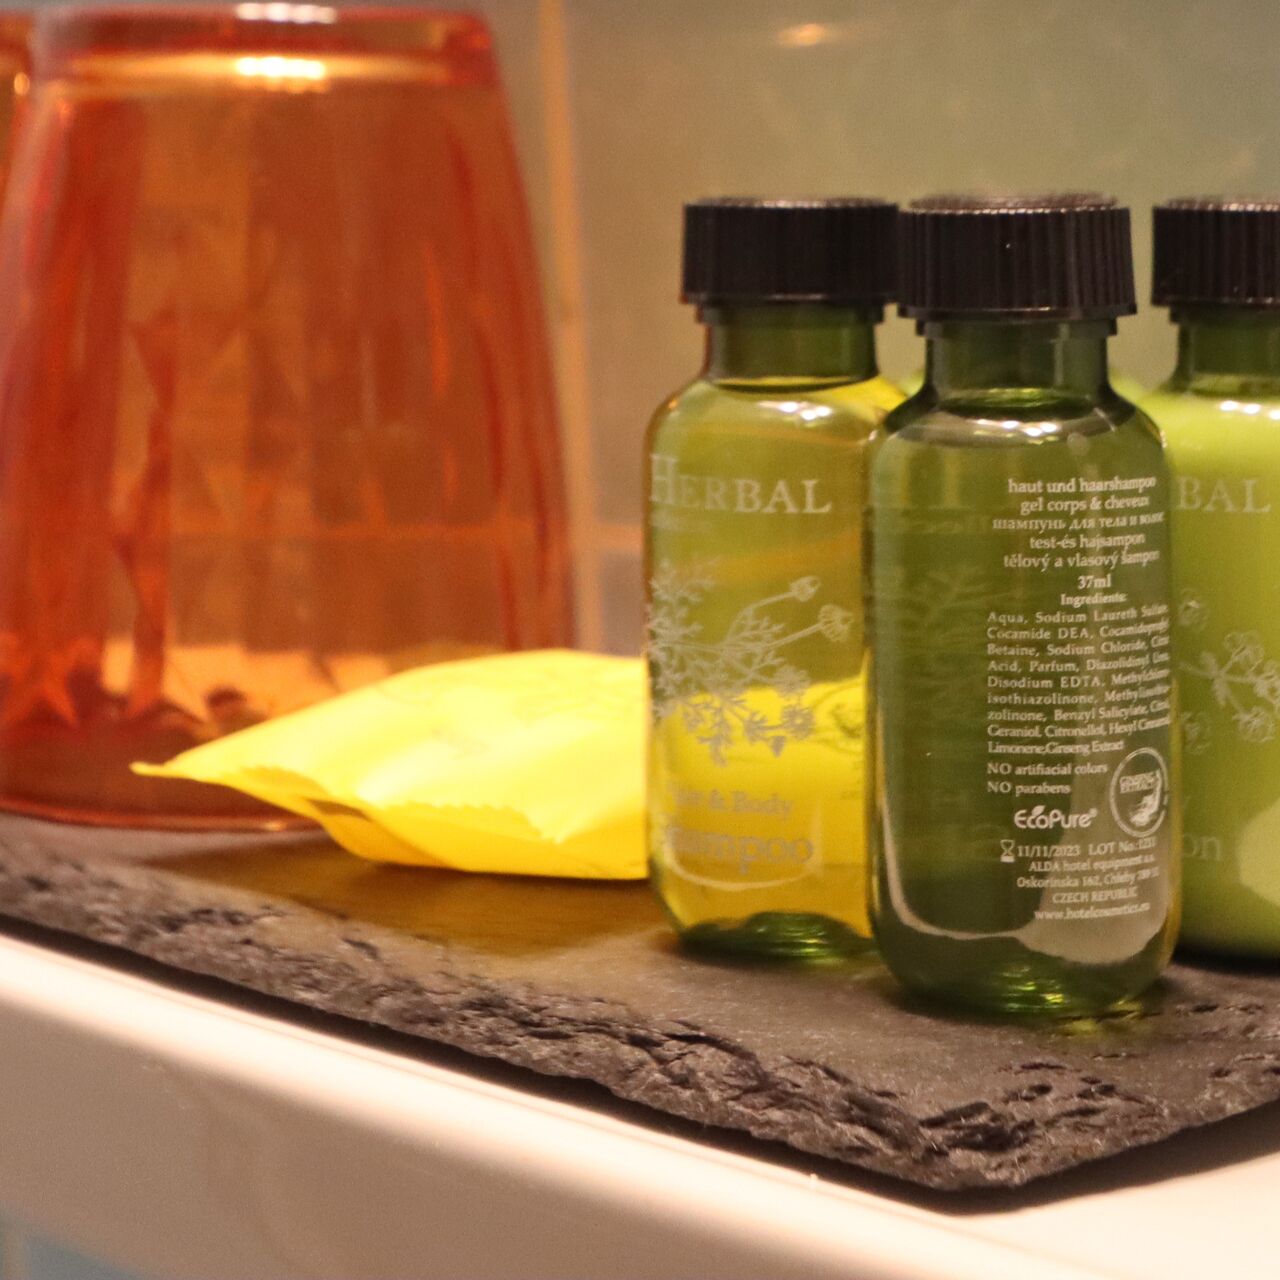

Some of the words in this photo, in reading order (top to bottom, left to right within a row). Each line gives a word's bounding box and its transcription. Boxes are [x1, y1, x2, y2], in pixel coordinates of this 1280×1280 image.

[650, 453, 832, 513] HERBAL
[1008, 479, 1044, 493] haut
[1047, 478, 1076, 493] und
[1020, 497, 1043, 515] gel
[1047, 499, 1087, 514] corps
[1089, 496, 1102, 511] &
[1054, 556, 1063, 567] a
[1067, 550, 1119, 569] vlasový
[1078, 574, 1111, 590] 37ml
[988, 612, 1028, 626] Aqua,
[1035, 612, 1087, 623] Sodium
[1094, 607, 1137, 622] Laureth
[987, 627, 1051, 639] Cocamide
[987, 644, 1040, 656] Betaine,
[1047, 644, 1095, 656] Sodium
[988, 661, 1022, 673] Acid,
[1029, 661, 1079, 672] Parfum,
[987, 676, 1053, 688] Disodium
[988, 693, 1098, 705] isothiazolinone,
[988, 710, 1047, 721] zolinone,
[1054, 709, 1095, 724] Benzyl
[987, 763, 1012, 775] NO
[987, 782, 1012, 793] NO
[1015, 782, 1071, 797] parabens
[1089, 842, 1115, 856] LOT
[1052, 892, 1088, 904] CZECH
